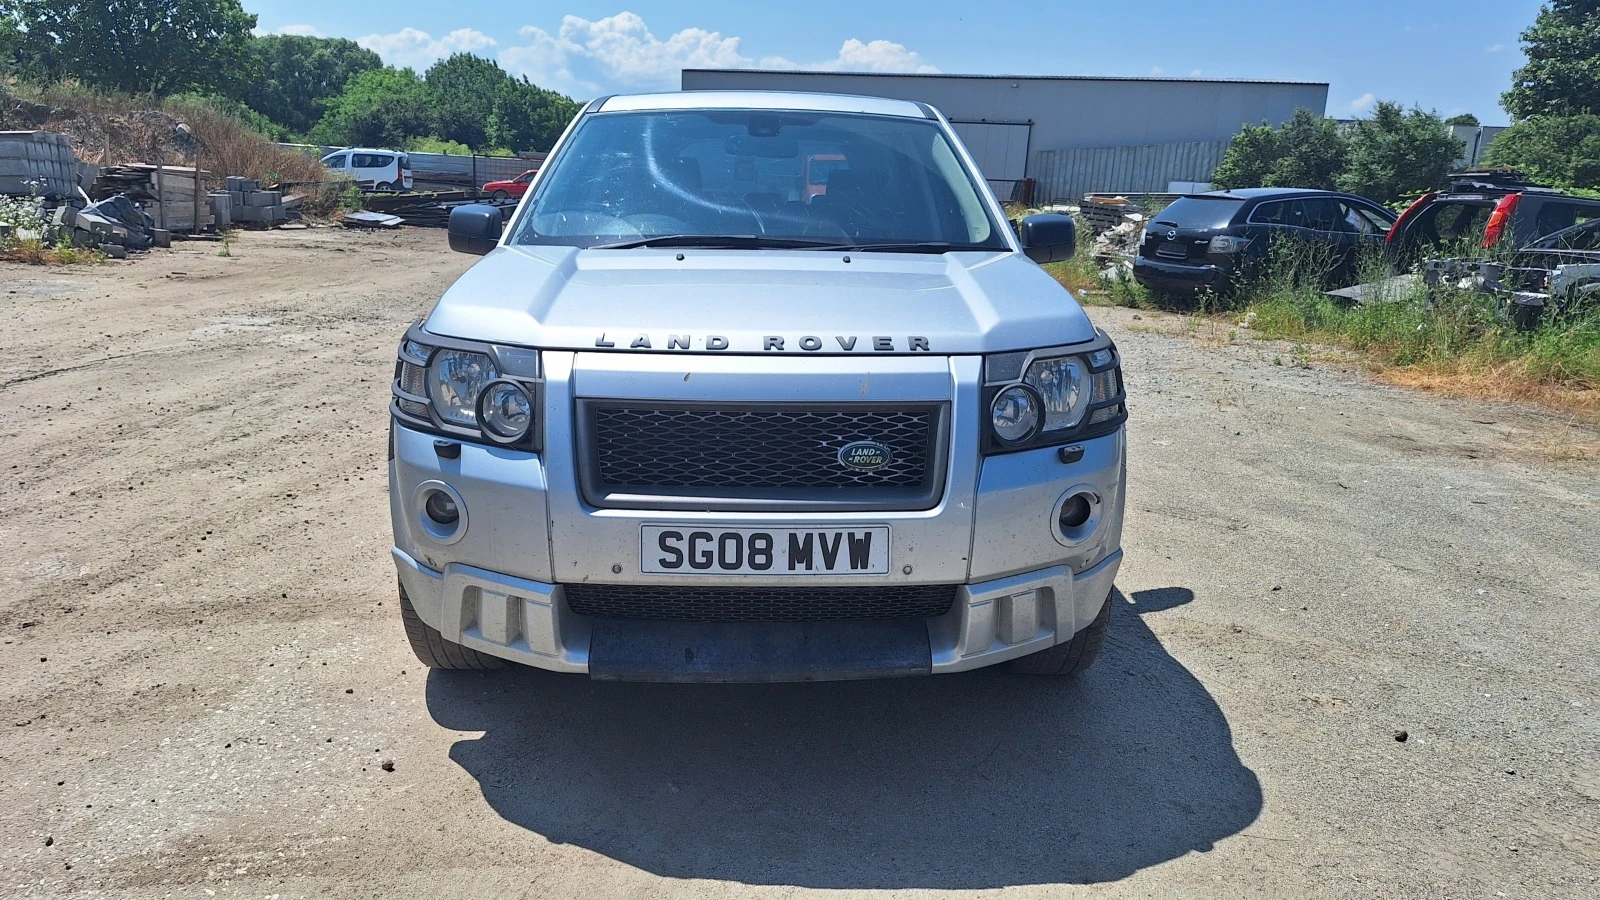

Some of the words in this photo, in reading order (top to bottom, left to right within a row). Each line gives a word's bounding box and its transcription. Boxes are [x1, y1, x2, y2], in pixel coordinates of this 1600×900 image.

[595, 333, 729, 350] LAND
[763, 335, 930, 351] ROVER
[658, 530, 774, 571] SG08
[787, 531, 872, 571] MVW
